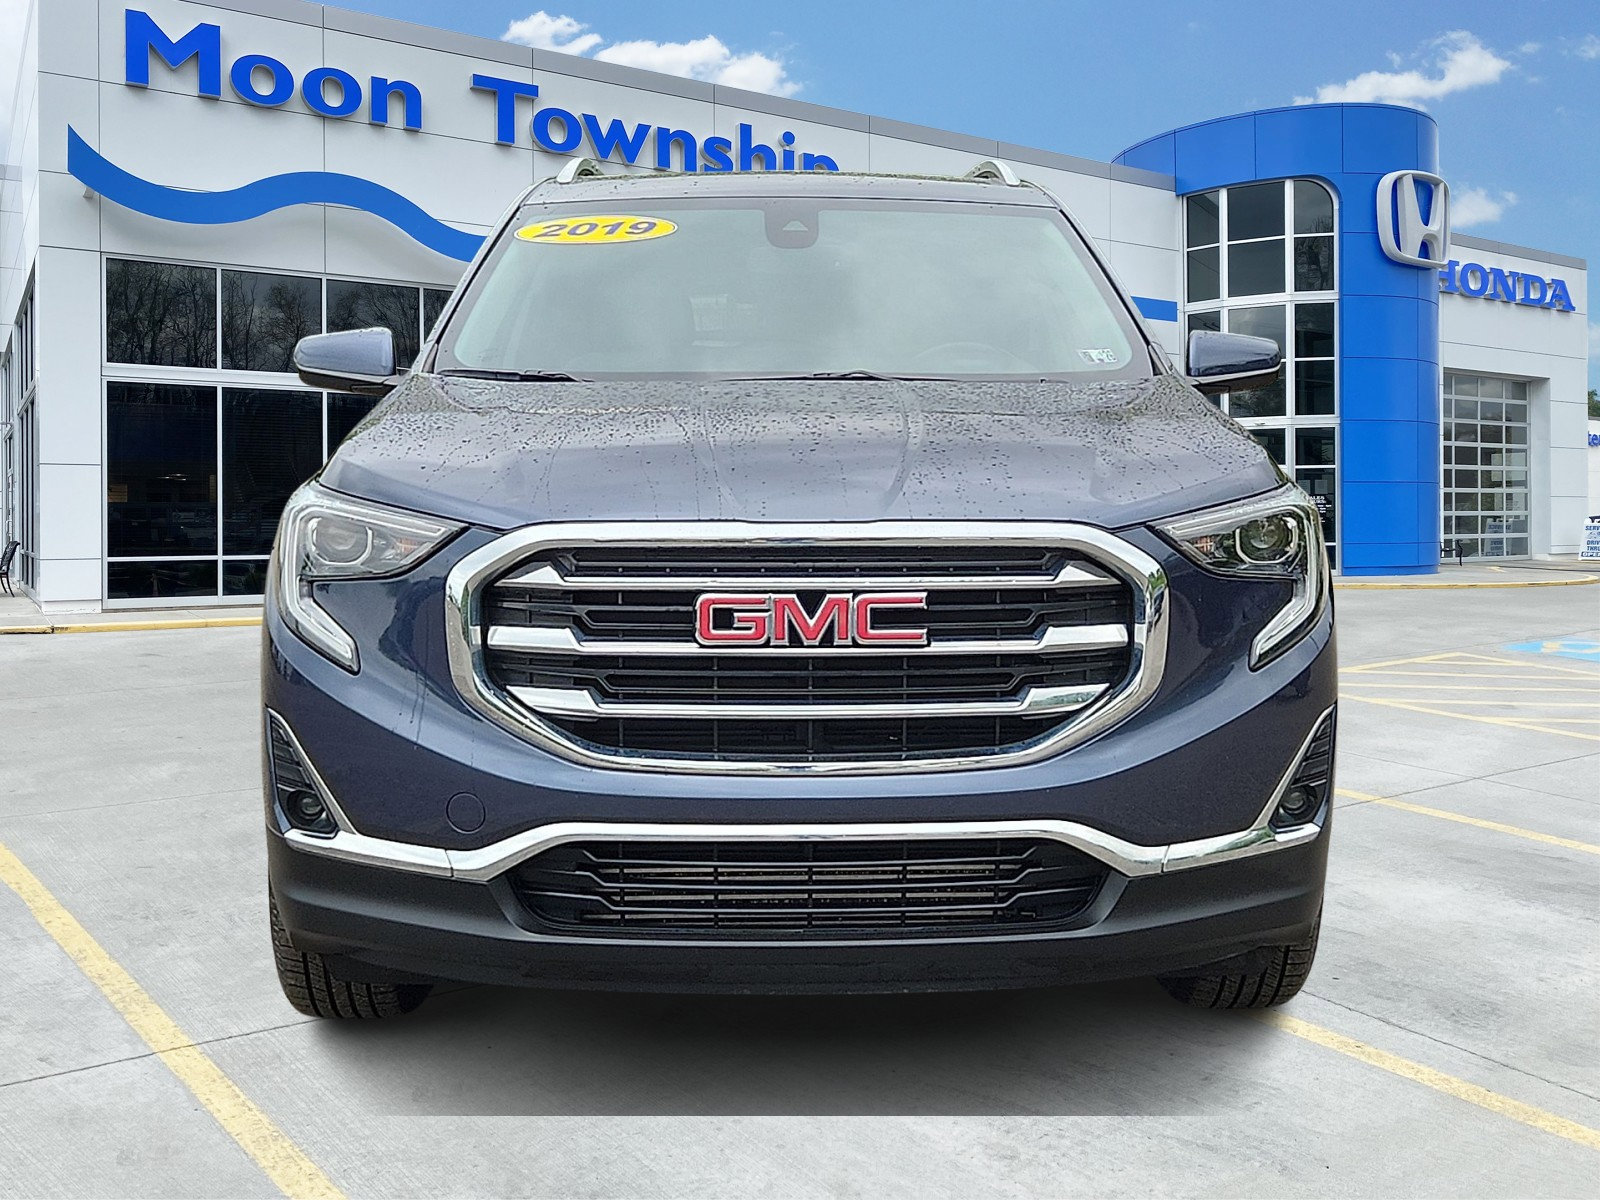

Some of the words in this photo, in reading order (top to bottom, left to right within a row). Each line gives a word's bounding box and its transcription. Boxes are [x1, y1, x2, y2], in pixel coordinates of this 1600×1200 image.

[125, 9, 422, 131] Moon
[533, 220, 658, 239] 2019
[1439, 259, 1576, 311] HONDA
[695, 591, 929, 646] GMC
